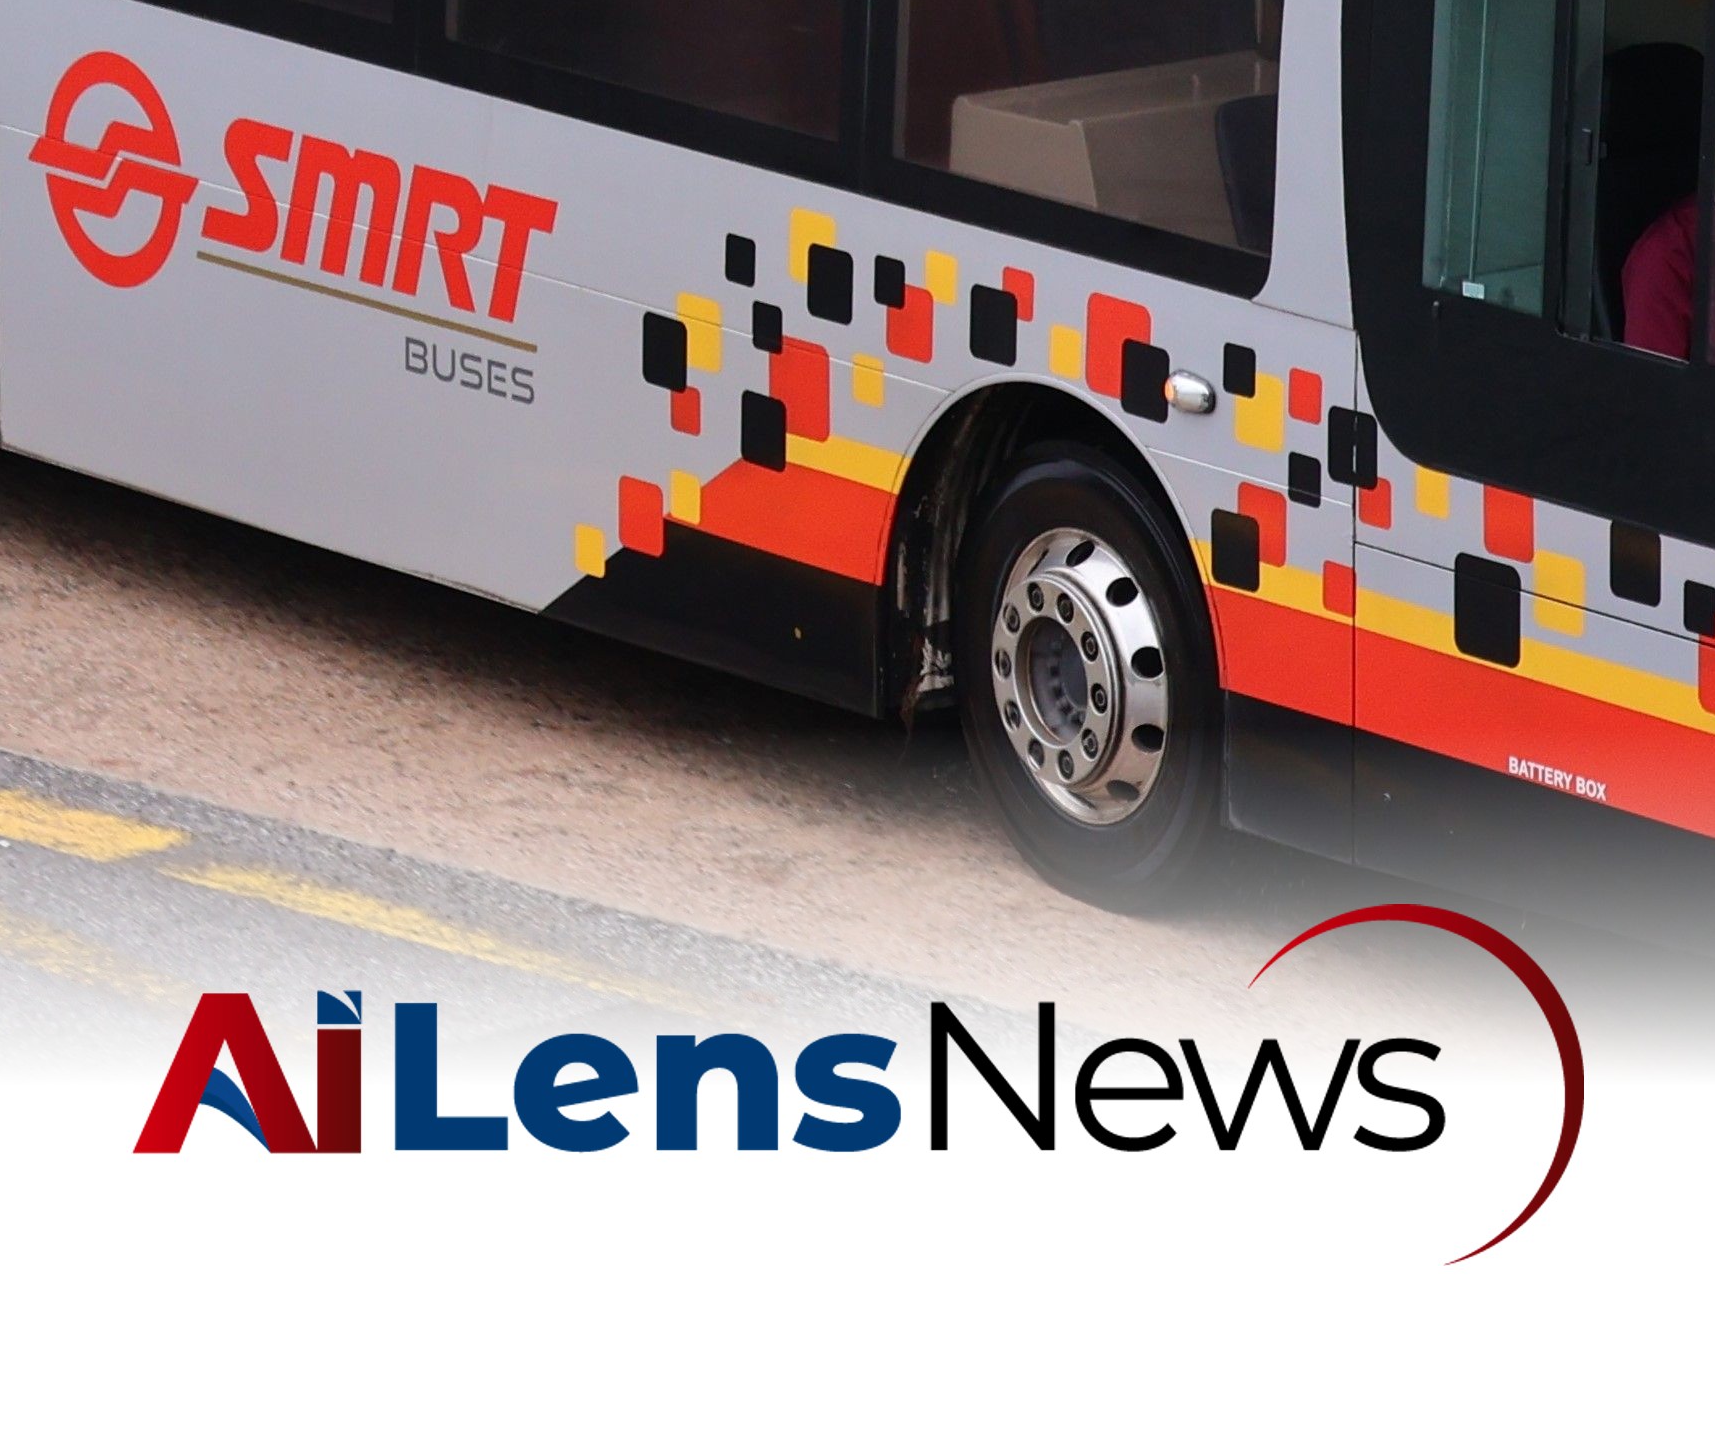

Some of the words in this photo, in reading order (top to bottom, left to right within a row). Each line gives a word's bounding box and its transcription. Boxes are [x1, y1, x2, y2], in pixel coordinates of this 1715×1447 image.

[200, 117, 558, 323] SMRT
[405, 336, 536, 404] BUSES
[1508, 756, 1574, 791] BATTERY
[1575, 775, 1607, 802] BOX
